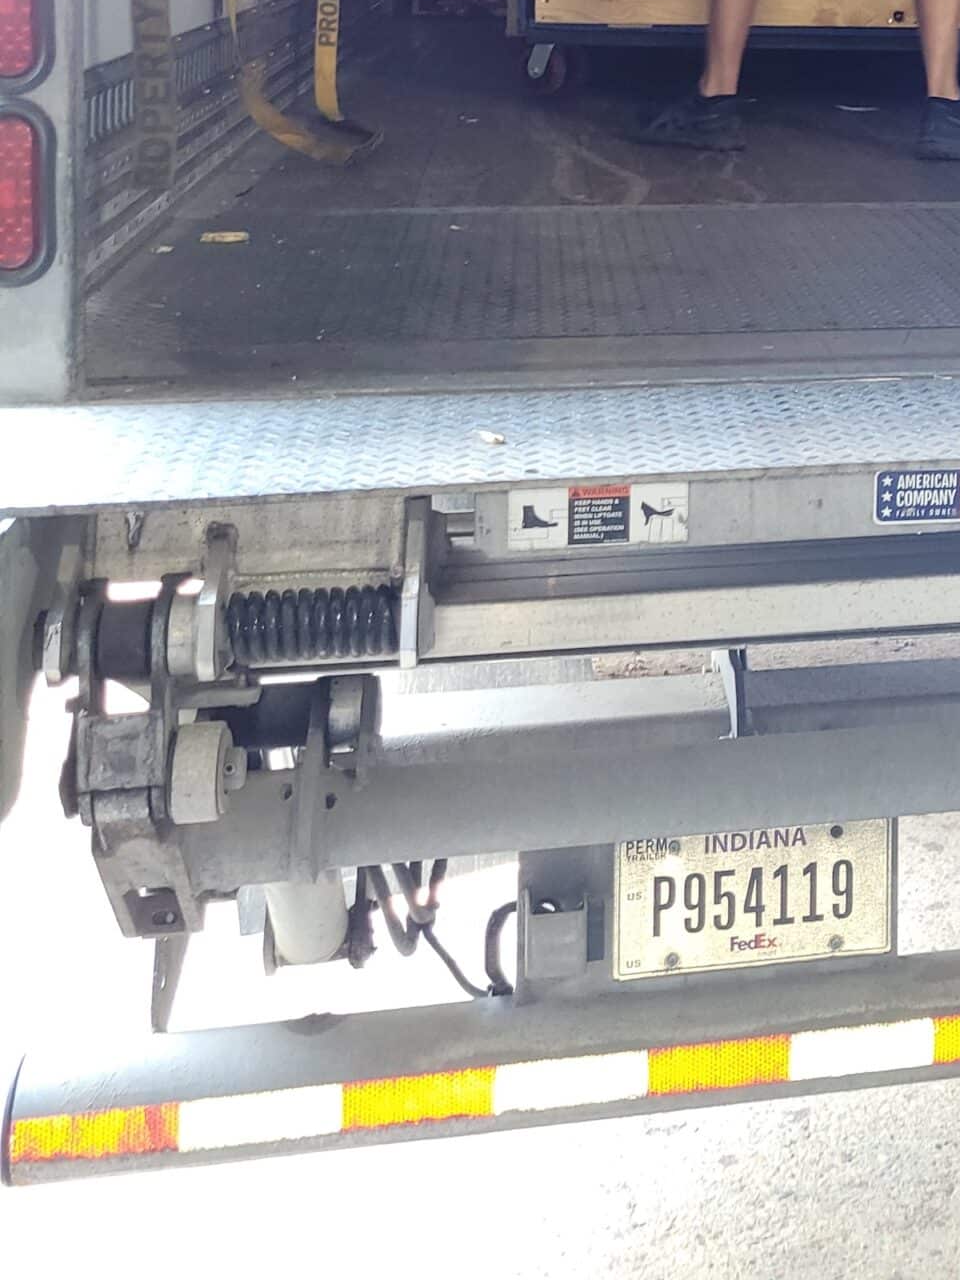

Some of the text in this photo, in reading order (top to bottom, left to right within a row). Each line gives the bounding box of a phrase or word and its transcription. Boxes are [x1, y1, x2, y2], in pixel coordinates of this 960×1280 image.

[897, 472, 957, 489] AMERICAN
[582, 486, 629, 496] WARNING
[896, 489, 956, 507] COMPANY
[626, 827, 807, 856] PERM INDIANA
[627, 892, 642, 901] US
[652, 859, 855, 938] P954119
[730, 933, 777, 952] FedEx
[626, 959, 641, 969] US
